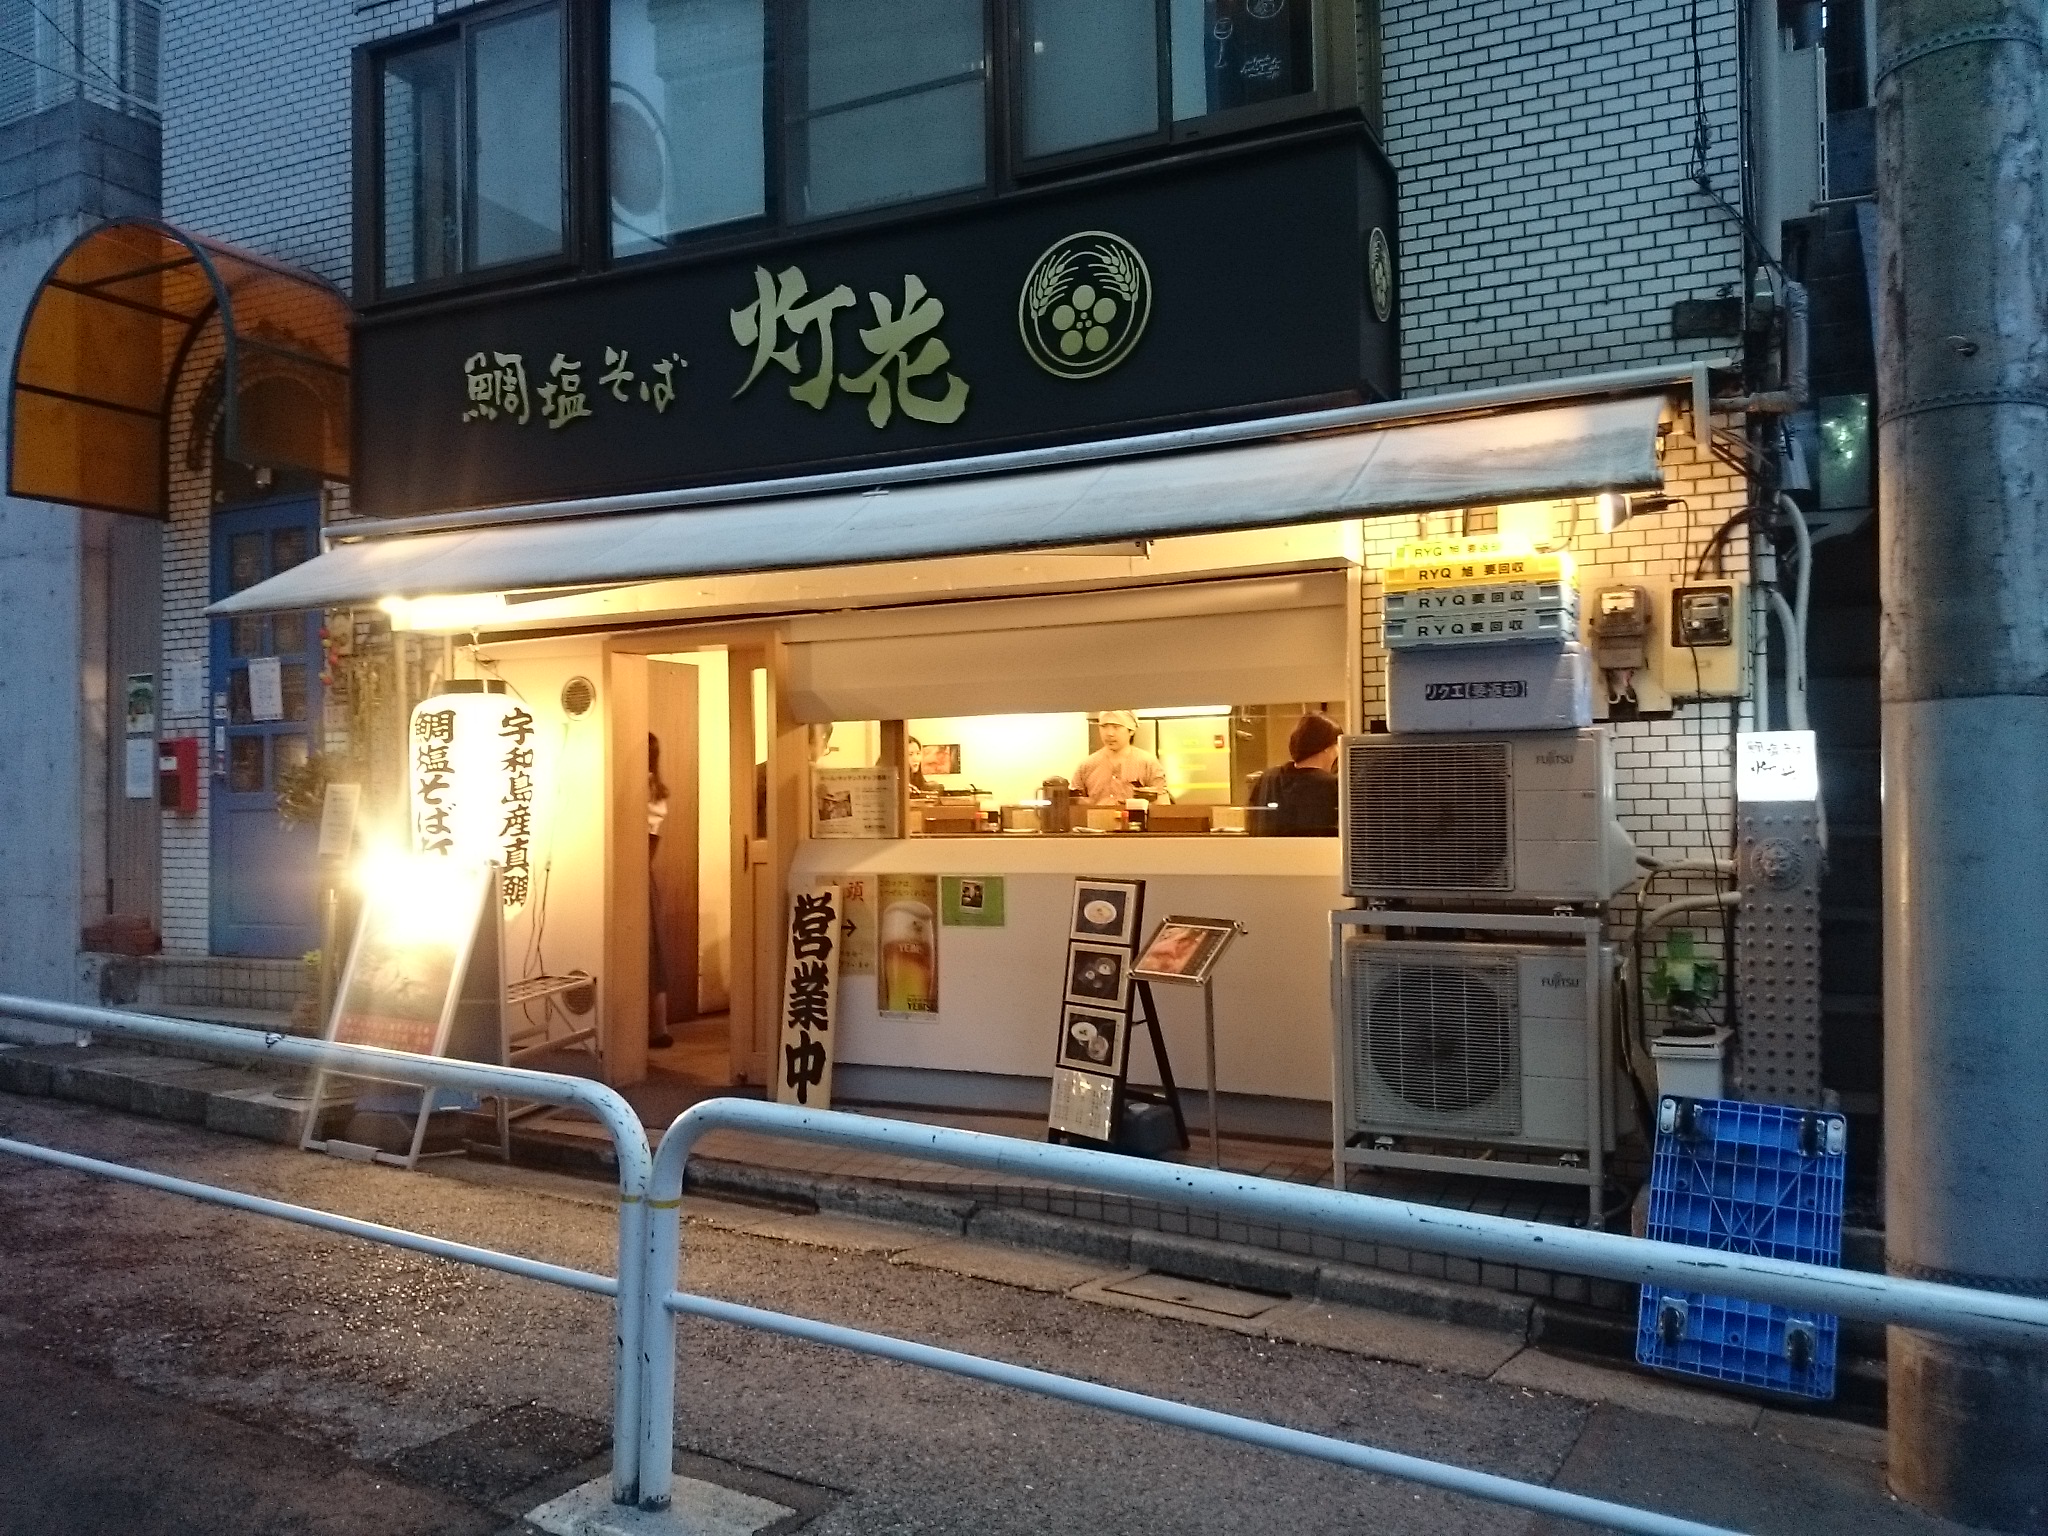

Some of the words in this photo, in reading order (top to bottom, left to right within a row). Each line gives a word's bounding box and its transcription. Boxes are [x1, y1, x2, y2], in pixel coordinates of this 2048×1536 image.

[462, 345, 690, 429] 鯛塩そば
[730, 264, 970, 429] 灯花
[1414, 546, 1442, 558] RYQ
[1419, 567, 1451, 581] RYQ
[1461, 565, 1473, 577] 旭
[1484, 562, 1525, 576] 要回収
[1419, 595, 1465, 608] RYQ
[1471, 590, 1525, 604] 要回収
[1418, 623, 1464, 637] RYQ
[1470, 619, 1524, 633] 要回収
[1536, 754, 1574, 765] FUJITSU
[498, 707, 535, 907] 宇和島産真鯛
[1541, 976, 1579, 988] FUJITSU
[786, 891, 836, 1104] 営業中
